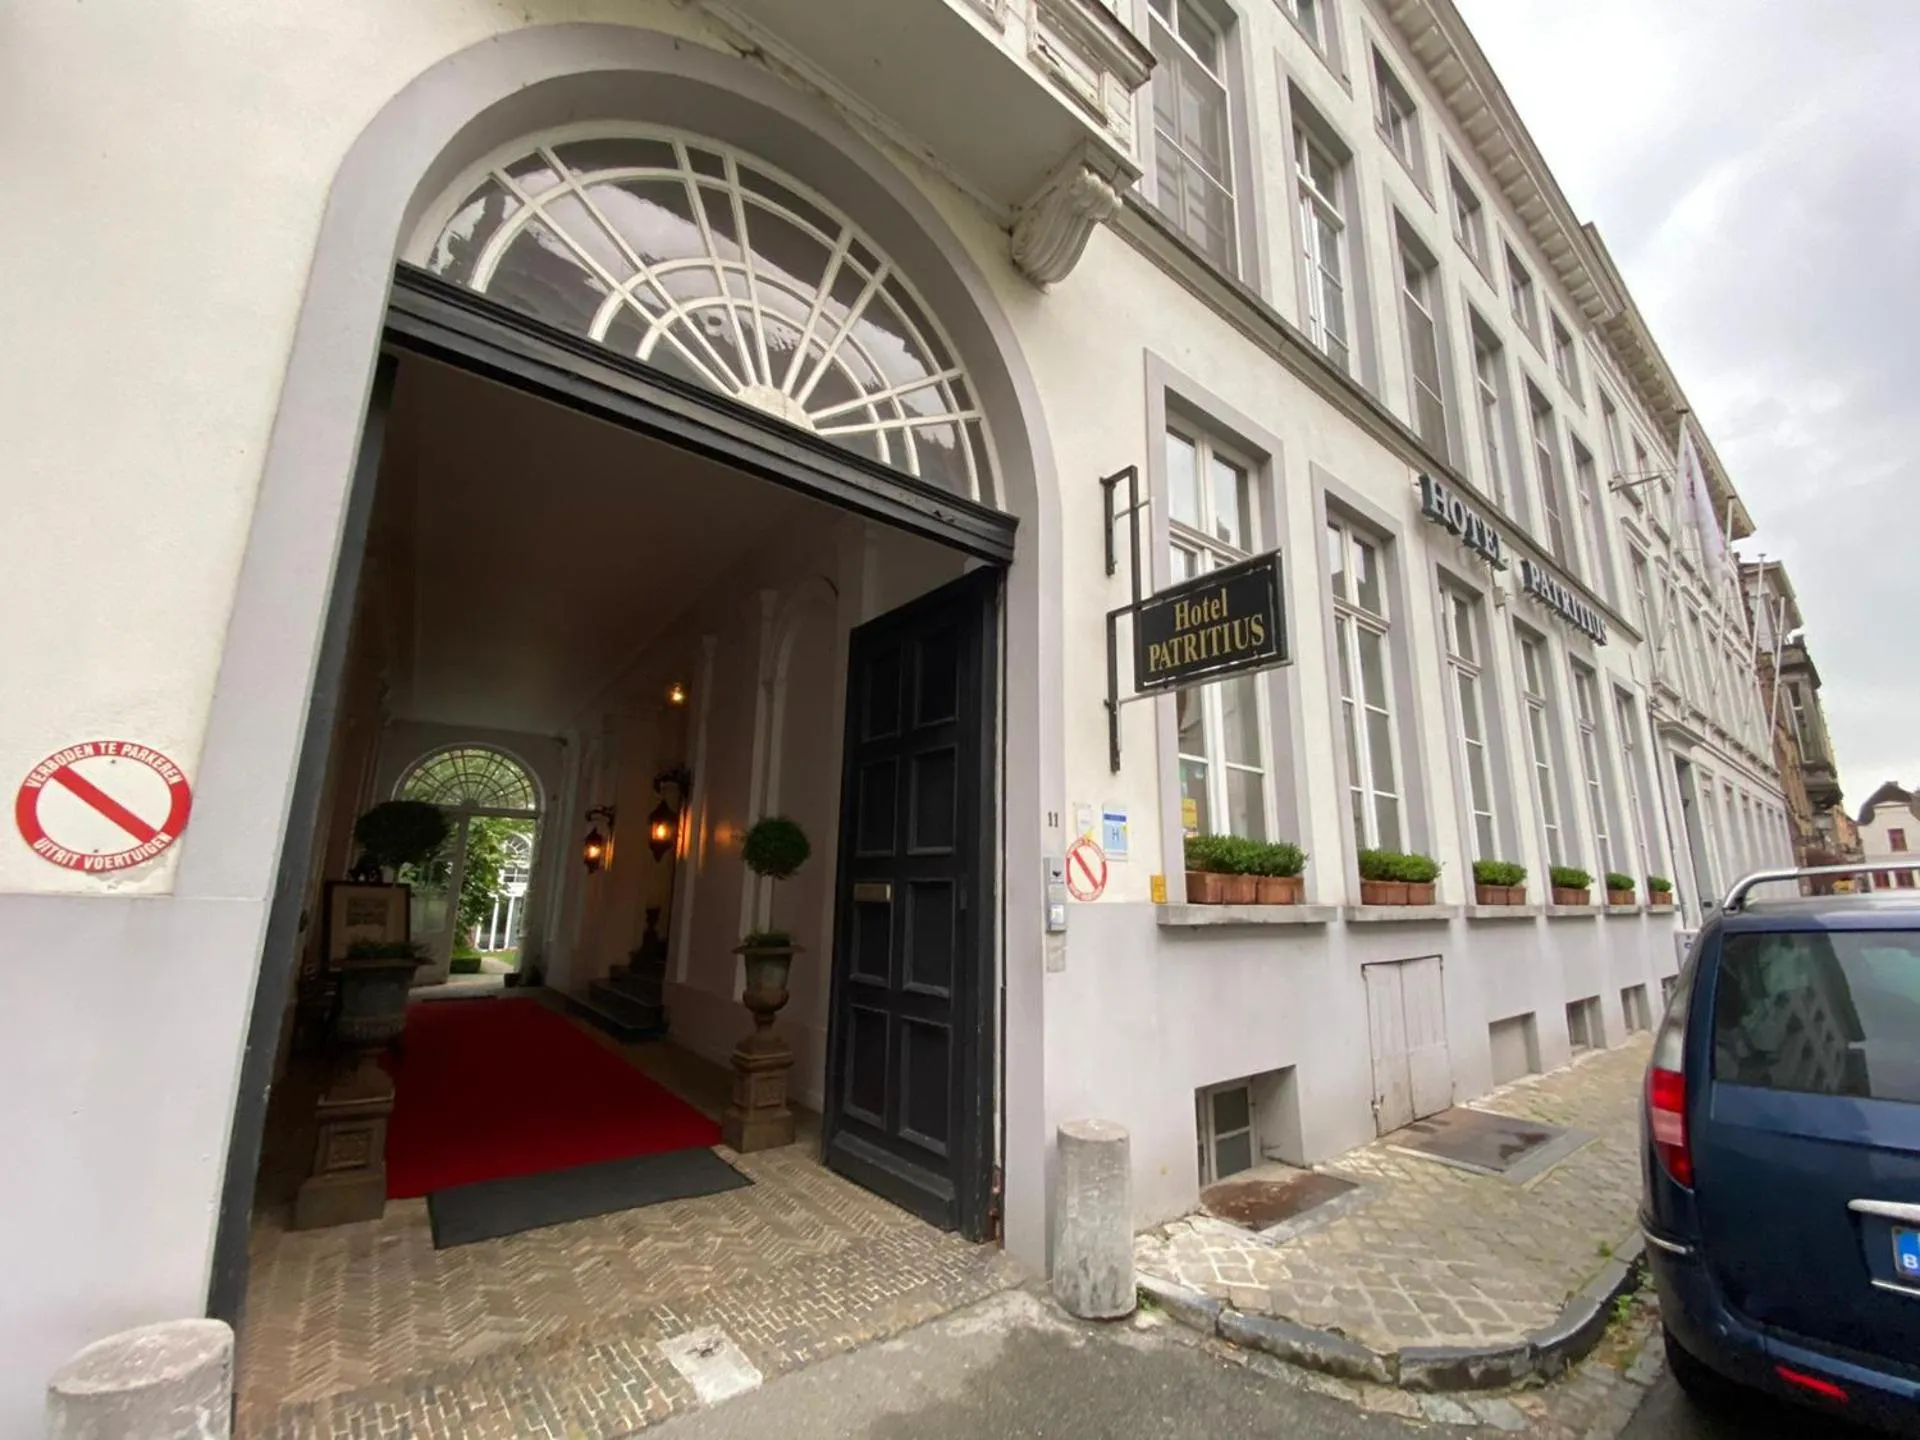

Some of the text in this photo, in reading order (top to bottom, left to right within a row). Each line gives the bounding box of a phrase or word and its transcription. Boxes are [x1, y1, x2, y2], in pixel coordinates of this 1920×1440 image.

[1422, 473, 1607, 645] HOTEL PATRITIUS
[1175, 588, 1228, 632] Hotel
[1149, 614, 1265, 672] PATRITIUS
[25, 743, 182, 788] VERBODEN TE PARKEREN
[1047, 811, 1059, 828] 11
[33, 832, 172, 869] UITRIT VOERTUIGEN
[1902, 1253, 1919, 1269] B
